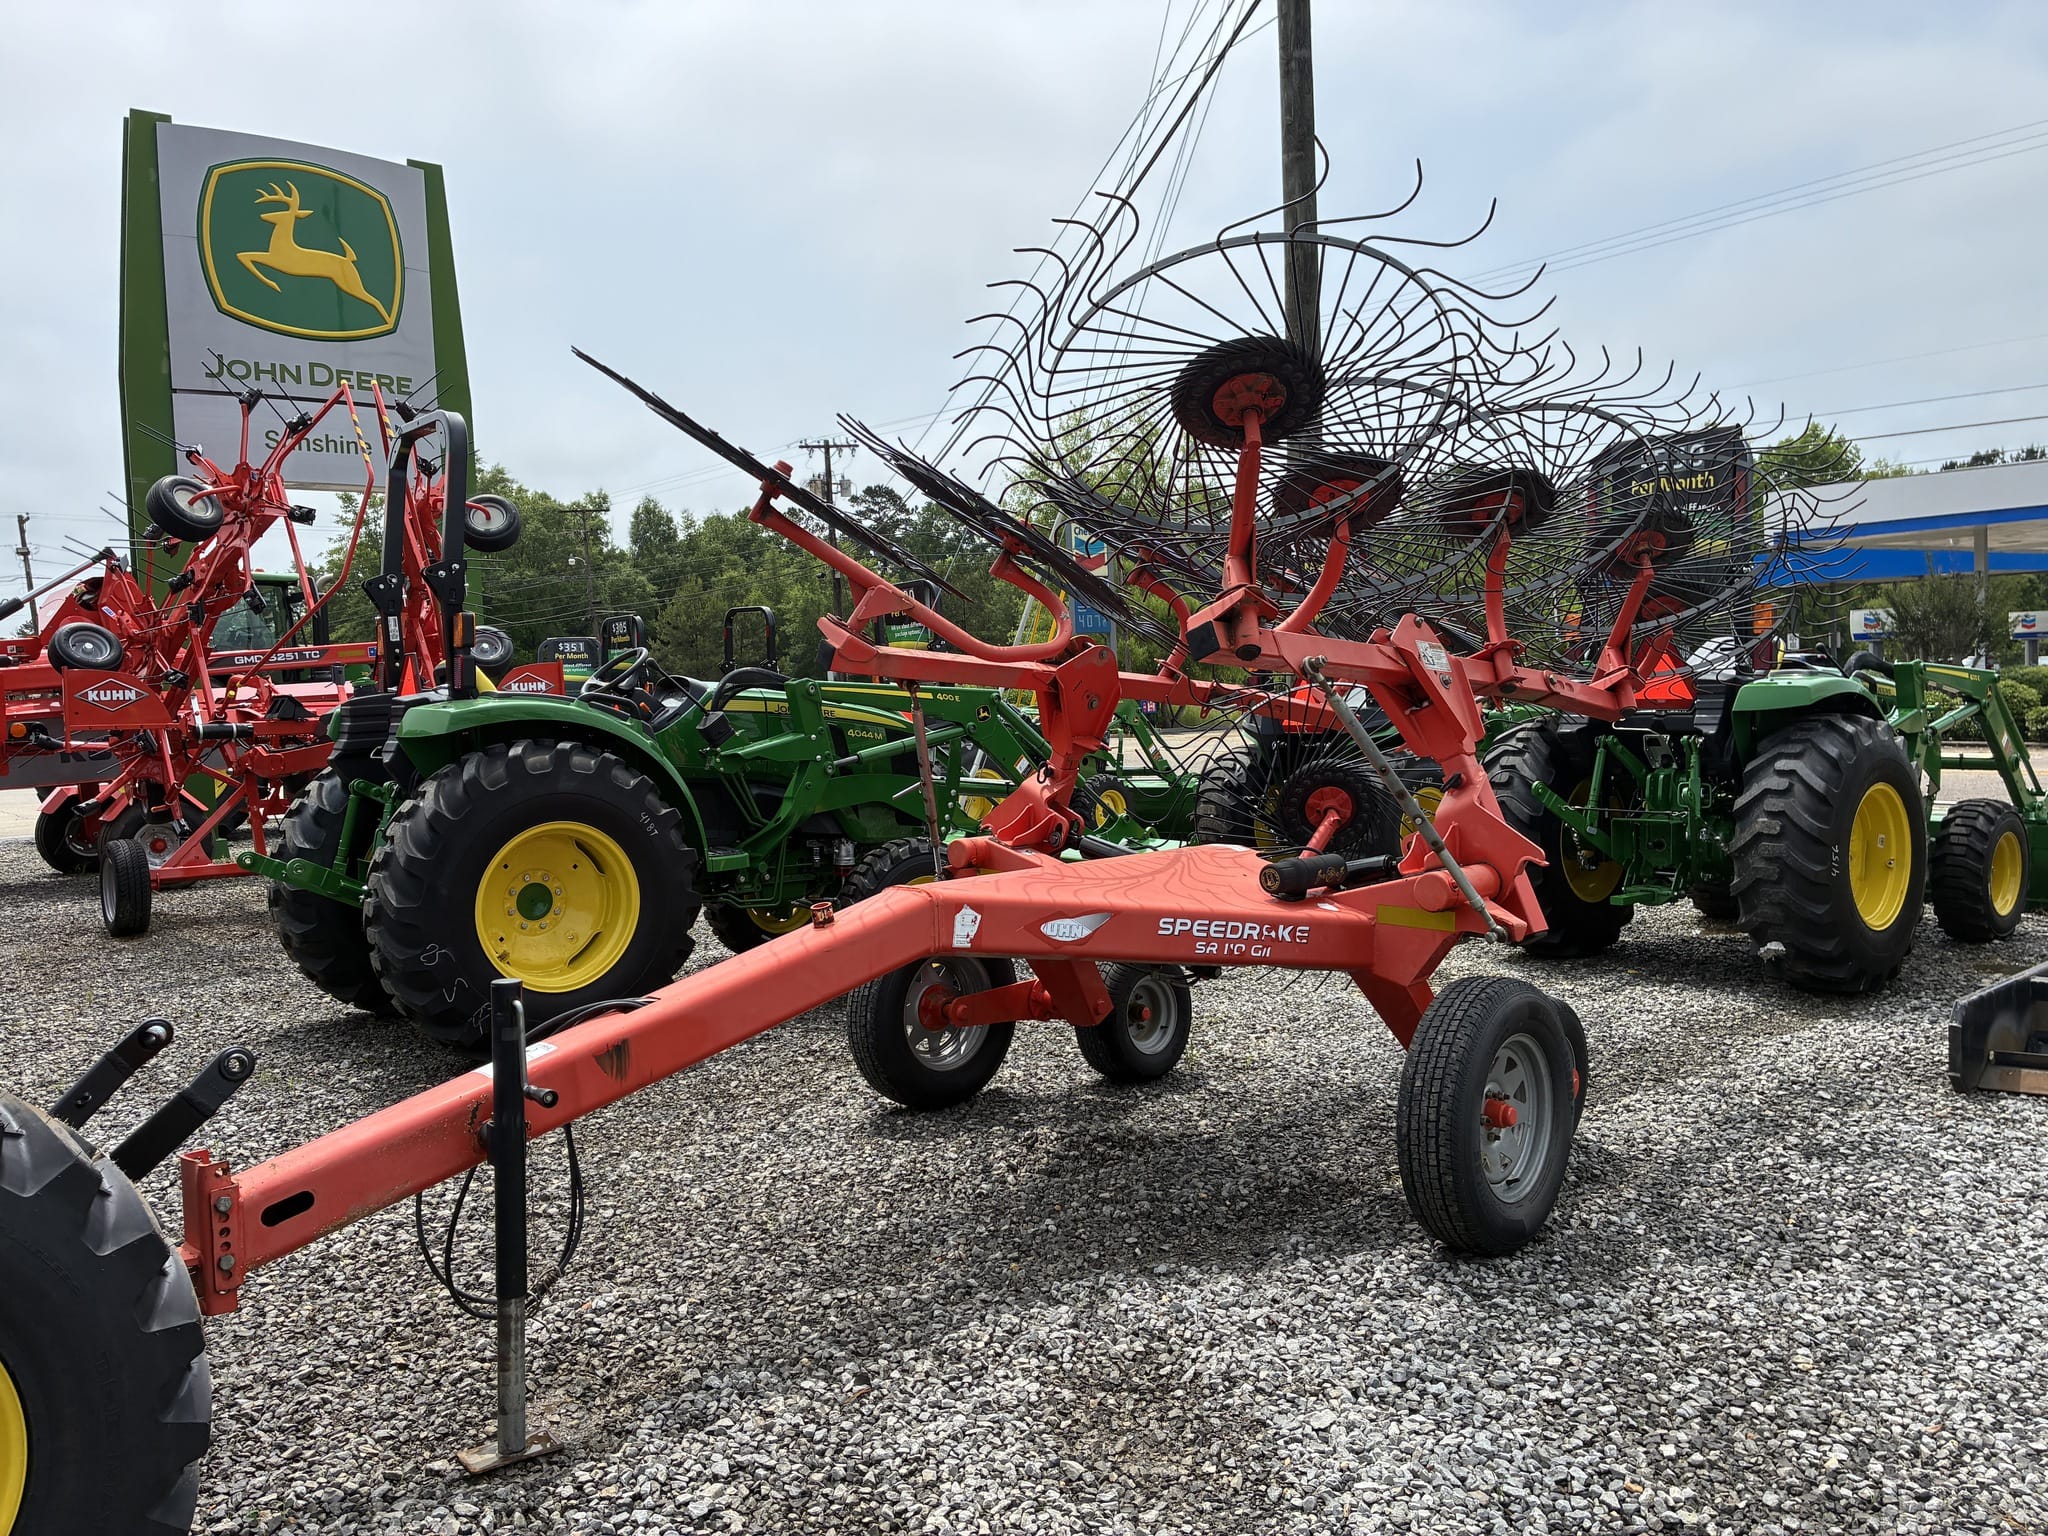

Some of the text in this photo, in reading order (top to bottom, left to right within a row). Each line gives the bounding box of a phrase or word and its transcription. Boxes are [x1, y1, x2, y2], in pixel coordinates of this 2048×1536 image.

[205, 353, 413, 396] JOHN DEERE
[264, 429, 373, 455] Snshine
[558, 642, 584, 652] $351
[234, 655, 264, 665] GMD
[302, 650, 320, 659] TC
[511, 681, 546, 692] KUHN
[87, 689, 136, 701] KUHN
[774, 703, 791, 714] JO
[1043, 922, 1084, 938] UHN
[1157, 917, 1311, 944] SPEEDRAKE
[1194, 941, 1218, 955] SR
